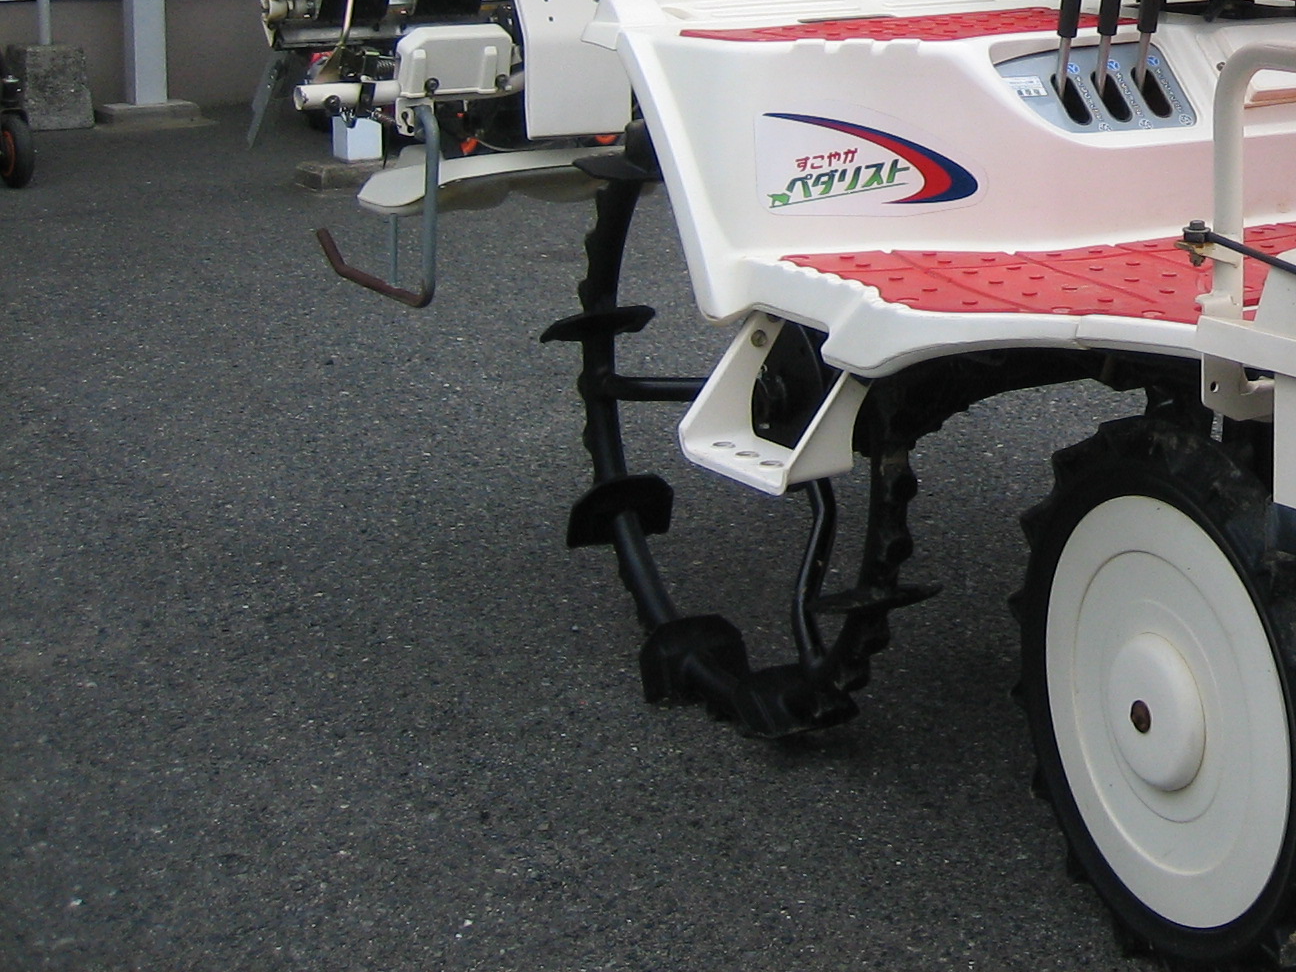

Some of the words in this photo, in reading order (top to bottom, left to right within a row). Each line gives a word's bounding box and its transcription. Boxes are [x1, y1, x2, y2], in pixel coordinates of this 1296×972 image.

[795, 148, 858, 172] すこやか
[785, 159, 911, 199] ペダリスト
